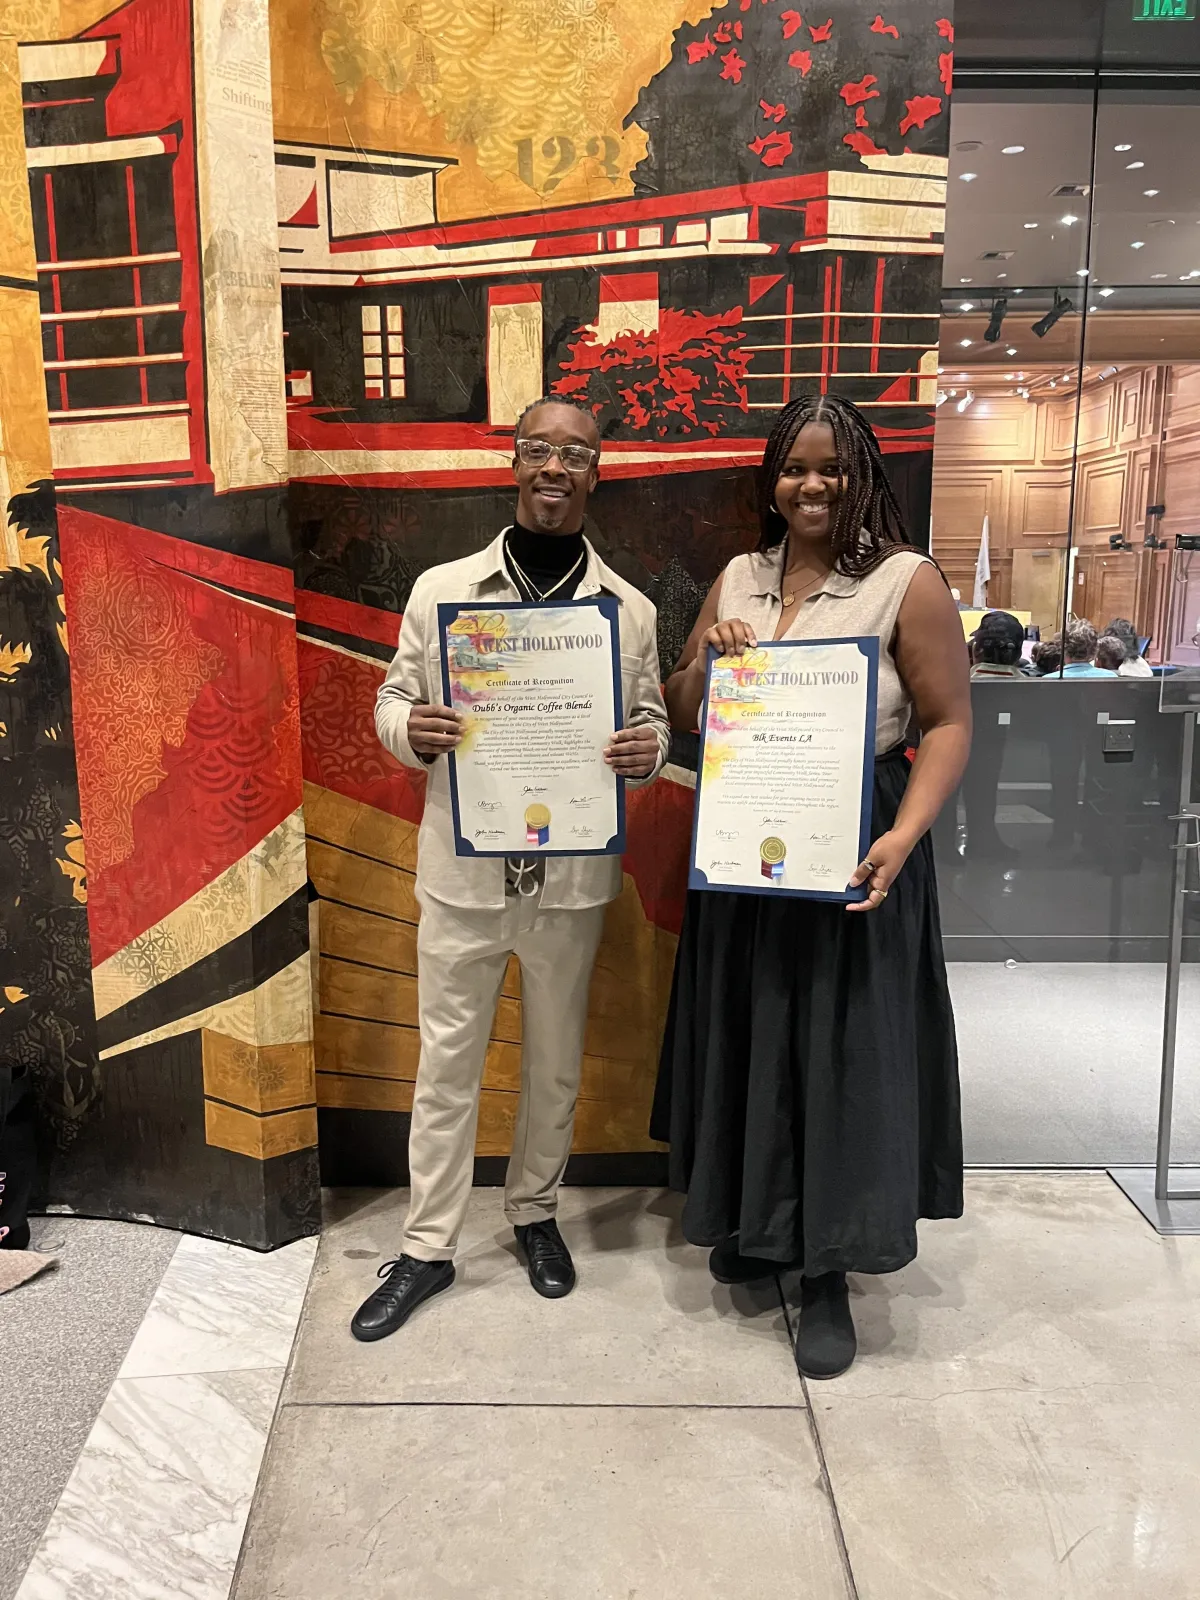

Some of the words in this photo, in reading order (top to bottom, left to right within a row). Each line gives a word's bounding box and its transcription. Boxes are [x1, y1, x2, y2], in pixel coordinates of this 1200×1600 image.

[222, 86, 272, 115] Shifting
[482, 638, 518, 652] WEST
[522, 634, 602, 651] HOLLYWOOD
[486, 678, 522, 687] Certificate
[532, 678, 574, 686] Recognition
[743, 672, 778, 686] WEST
[780, 671, 858, 686] HOLLYWOOD
[472, 703, 502, 712] Dubb's
[504, 703, 535, 714] Organic
[538, 702, 563, 713] Coffee
[565, 700, 592, 710] Blends
[752, 733, 768, 743] Blk
[799, 734, 812, 743] LA
